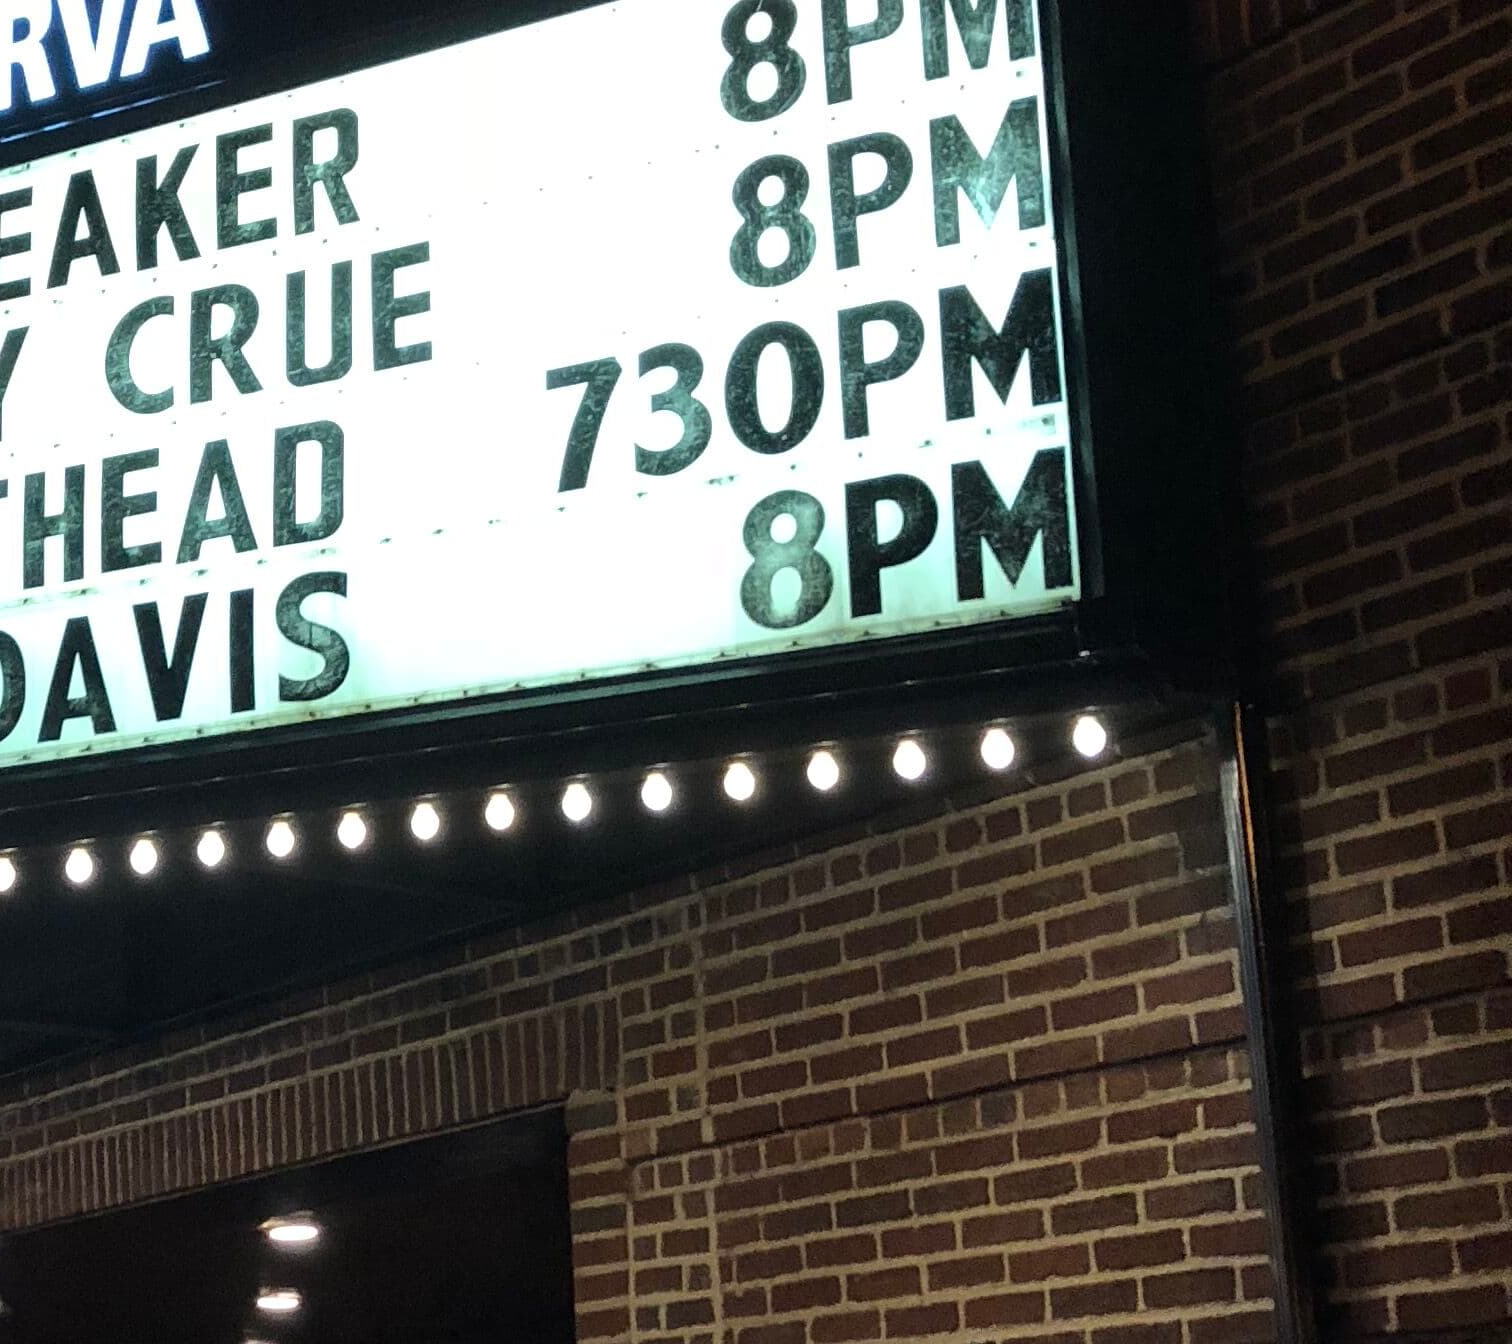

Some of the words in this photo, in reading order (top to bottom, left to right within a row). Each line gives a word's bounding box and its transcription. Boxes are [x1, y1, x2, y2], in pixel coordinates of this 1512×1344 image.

[729, 95, 1048, 288] 8PM
[104, 239, 434, 416] CRUE
[545, 267, 1064, 494] 730PM
[740, 446, 1074, 630] 8PM
